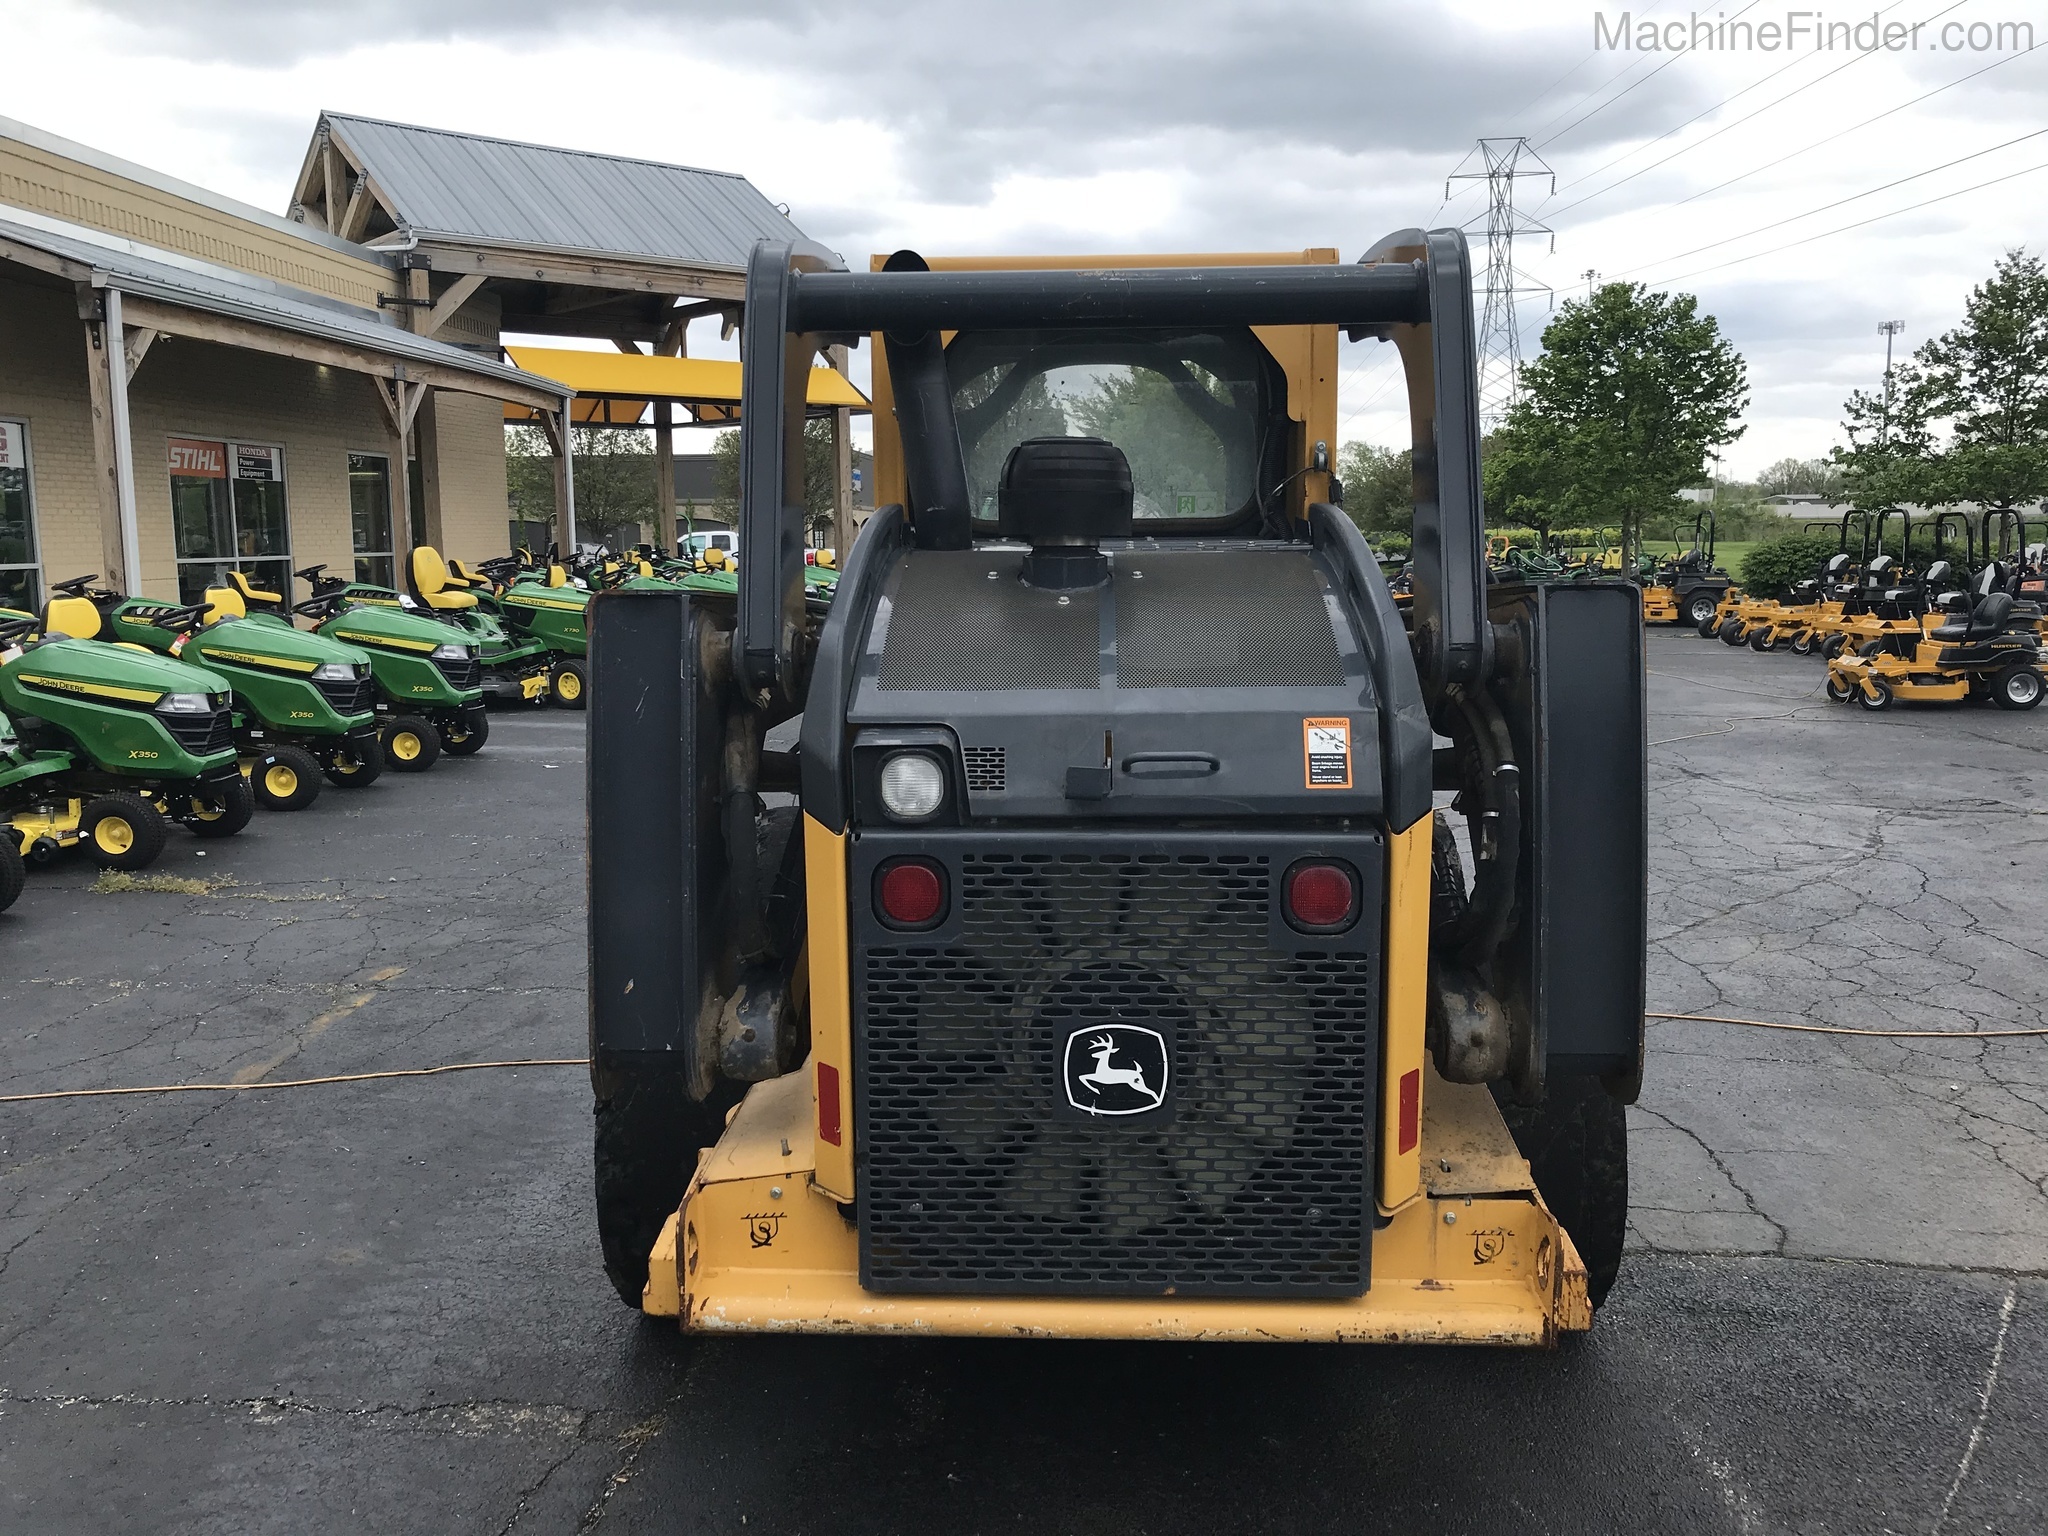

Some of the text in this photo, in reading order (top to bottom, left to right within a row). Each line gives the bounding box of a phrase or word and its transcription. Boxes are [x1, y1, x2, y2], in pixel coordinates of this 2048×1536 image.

[239, 446, 267, 457] HONDA
[169, 447, 220, 471] STIHL
[239, 458, 255, 466] Power
[240, 468, 265, 478] Equipment
[350, 633, 383, 644] JOHN DEERE
[218, 651, 256, 664] JOHN DEERE
[38, 678, 86, 693] JOHN DEERE
[290, 711, 314, 719] X350
[128, 750, 158, 759] X350
